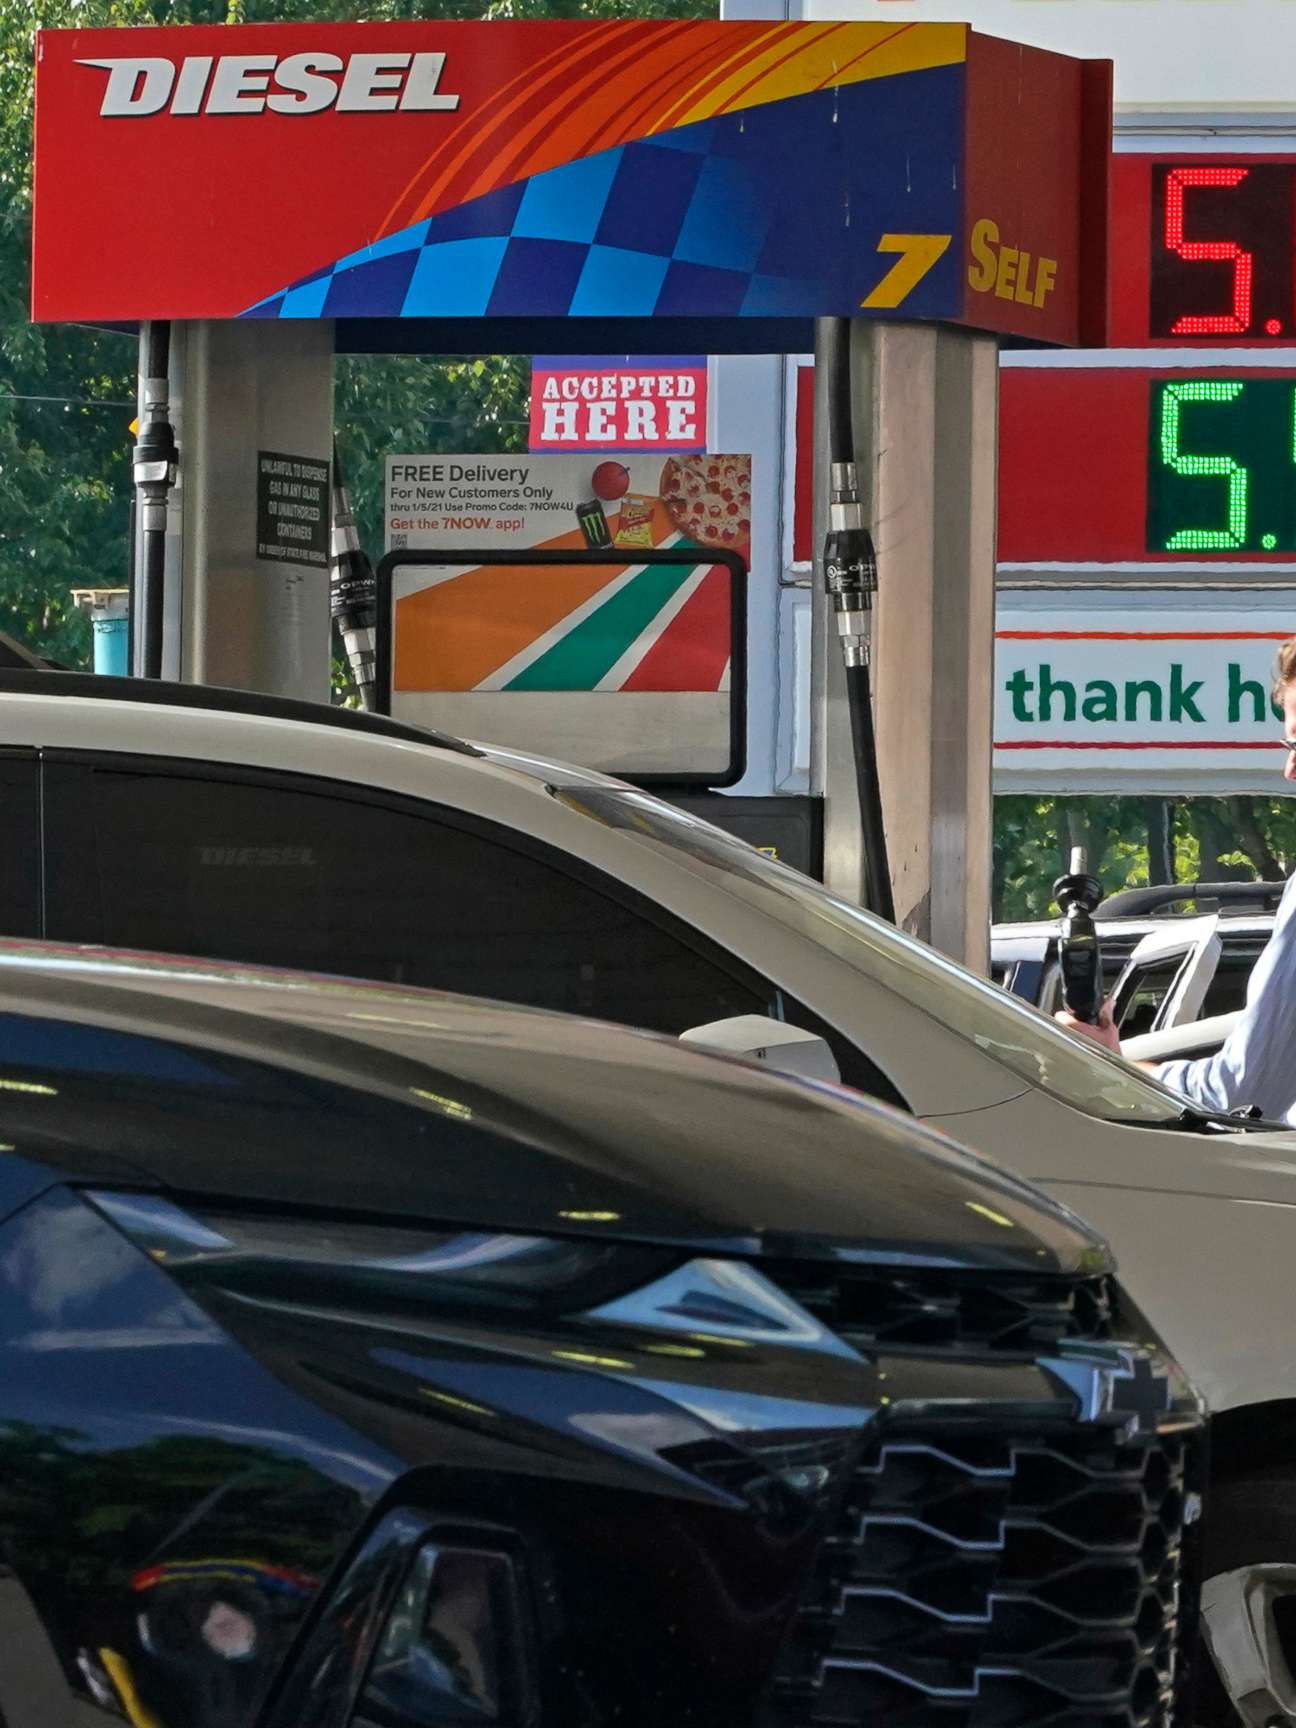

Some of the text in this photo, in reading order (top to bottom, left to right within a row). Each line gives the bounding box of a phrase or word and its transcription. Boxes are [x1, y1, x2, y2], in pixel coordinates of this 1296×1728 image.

[75, 51, 460, 118] DIESEL
[860, 233, 953, 309] 7
[541, 374, 696, 400] ACCEPTED
[541, 400, 697, 442] HERE
[391, 465, 529, 485] FREE Delivery
[390, 486, 553, 501] For New Customers Only
[390, 501, 574, 512] thru 1/5/21 Use Promo Code: 7NOW4U
[391, 517, 525, 532] Get the 7NOW app!
[1005, 662, 1204, 724] thank
